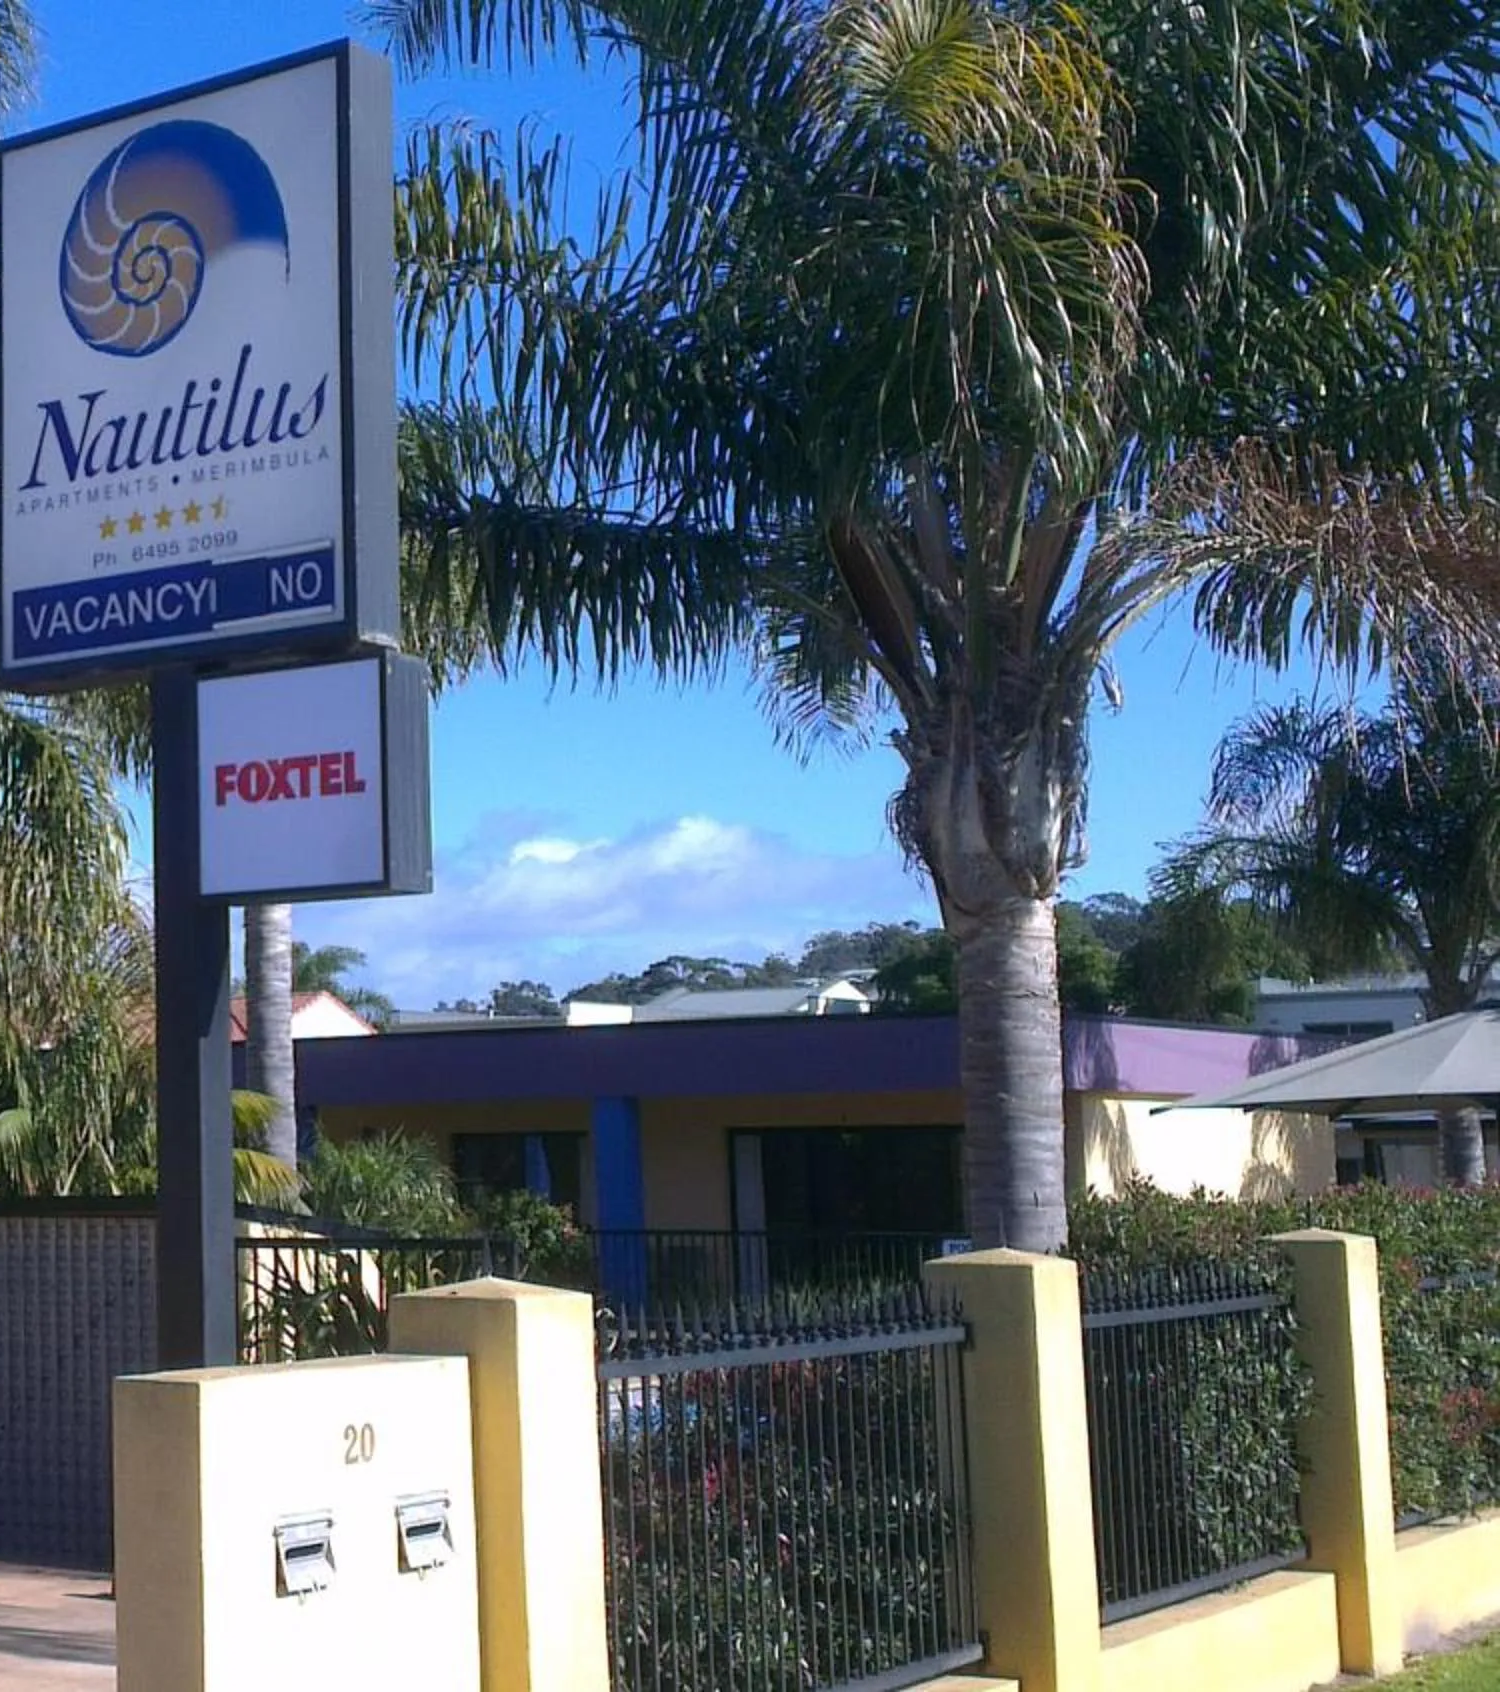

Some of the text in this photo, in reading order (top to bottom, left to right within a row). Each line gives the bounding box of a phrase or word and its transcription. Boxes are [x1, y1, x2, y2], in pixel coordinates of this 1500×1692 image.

[18, 344, 329, 491] Nautilus
[16, 445, 330, 516] APARTMENTS MERIMBULA
[93, 529, 238, 569] Ph 6495 2099
[270, 561, 323, 606] NO
[215, 751, 367, 806] FOXTEL
[343, 1422, 375, 1465] 20
